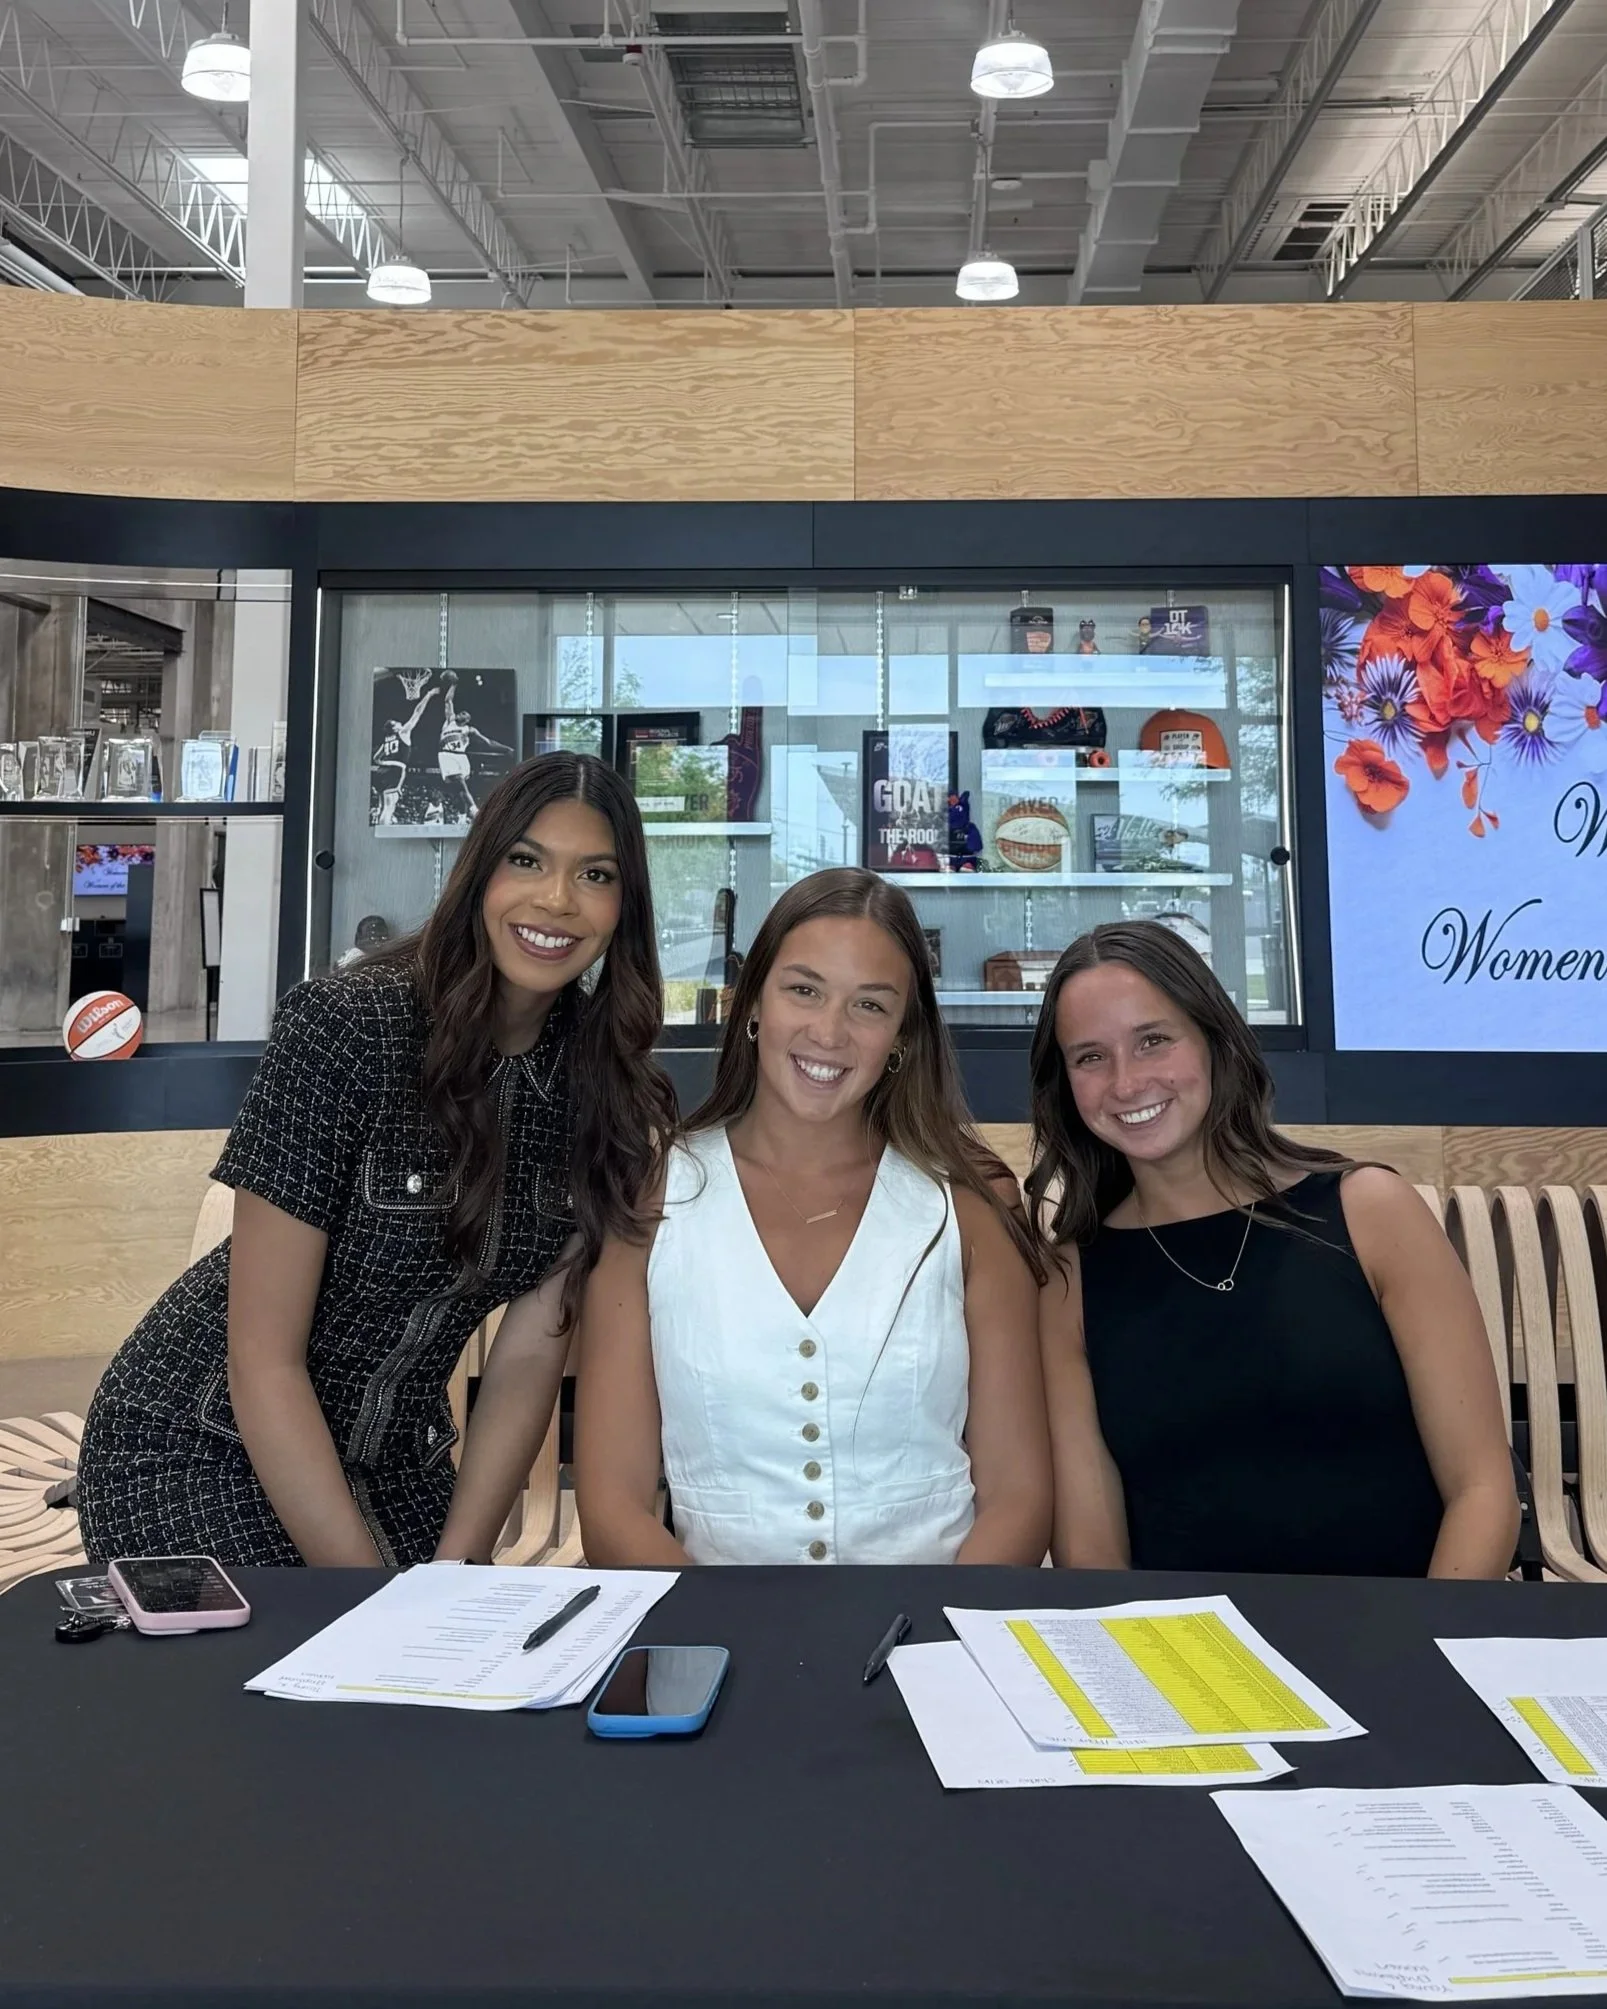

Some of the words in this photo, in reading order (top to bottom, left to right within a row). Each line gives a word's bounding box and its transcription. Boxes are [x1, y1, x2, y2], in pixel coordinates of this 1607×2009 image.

[384, 739, 399, 756] 10
[873, 779, 943, 813] GOAT
[879, 828, 903, 844] THE
[1421, 899, 1607, 985] Women
